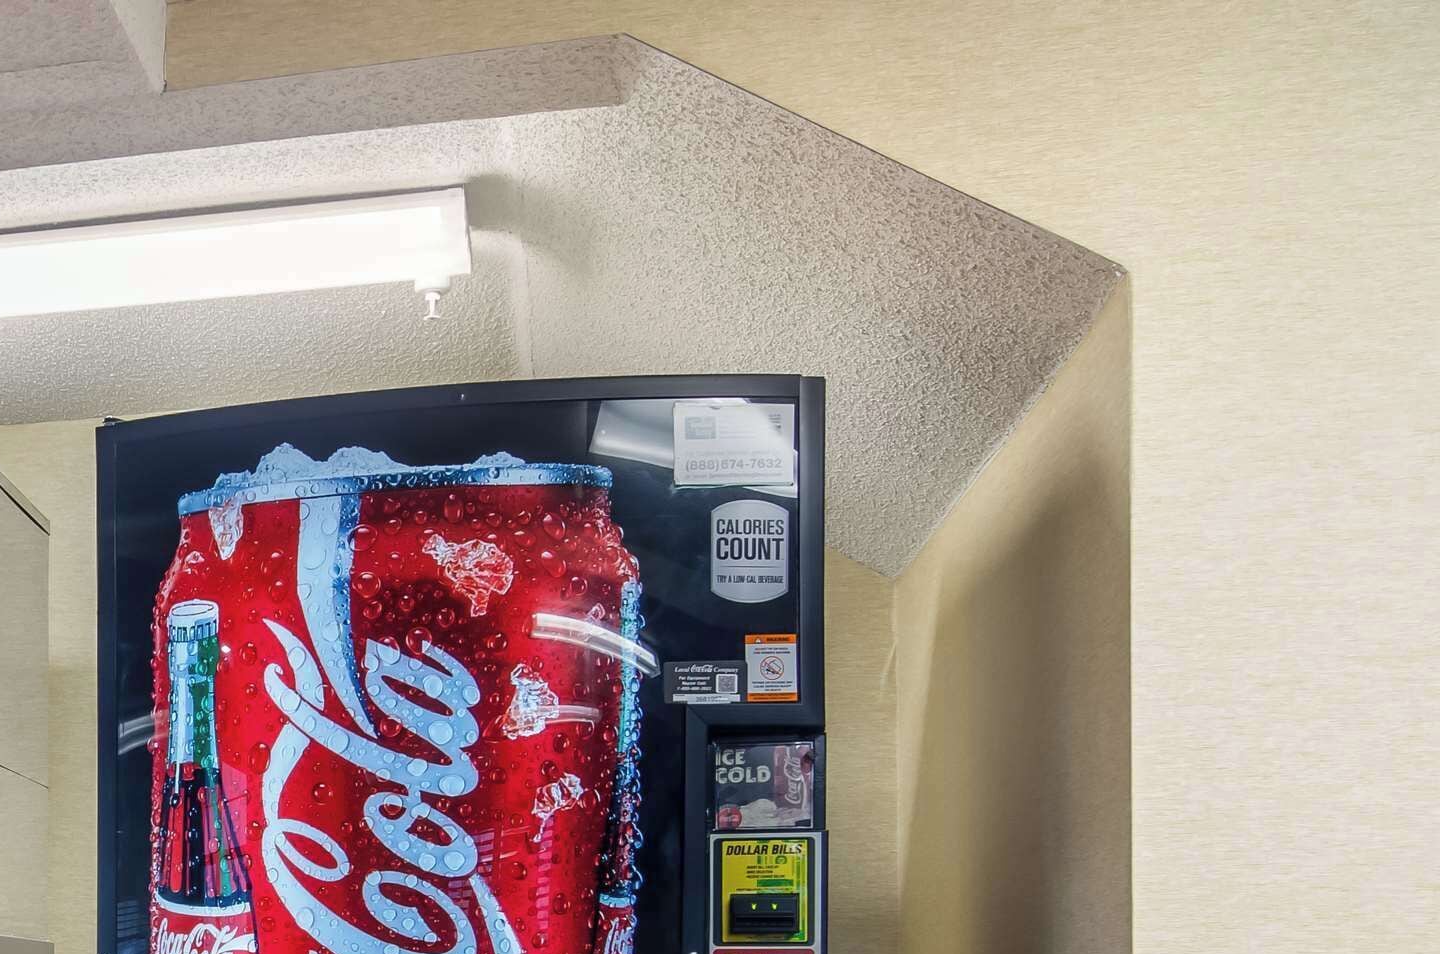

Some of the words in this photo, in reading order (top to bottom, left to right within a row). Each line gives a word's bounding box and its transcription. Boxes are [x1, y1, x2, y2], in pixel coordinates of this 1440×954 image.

[716, 519, 785, 536] CALORIES
[716, 537, 784, 561] COUNT
[715, 748, 746, 766] ICE
[715, 765, 771, 784] COLD
[726, 845, 769, 856] DOLLAR
[771, 843, 803, 855] BILLS
